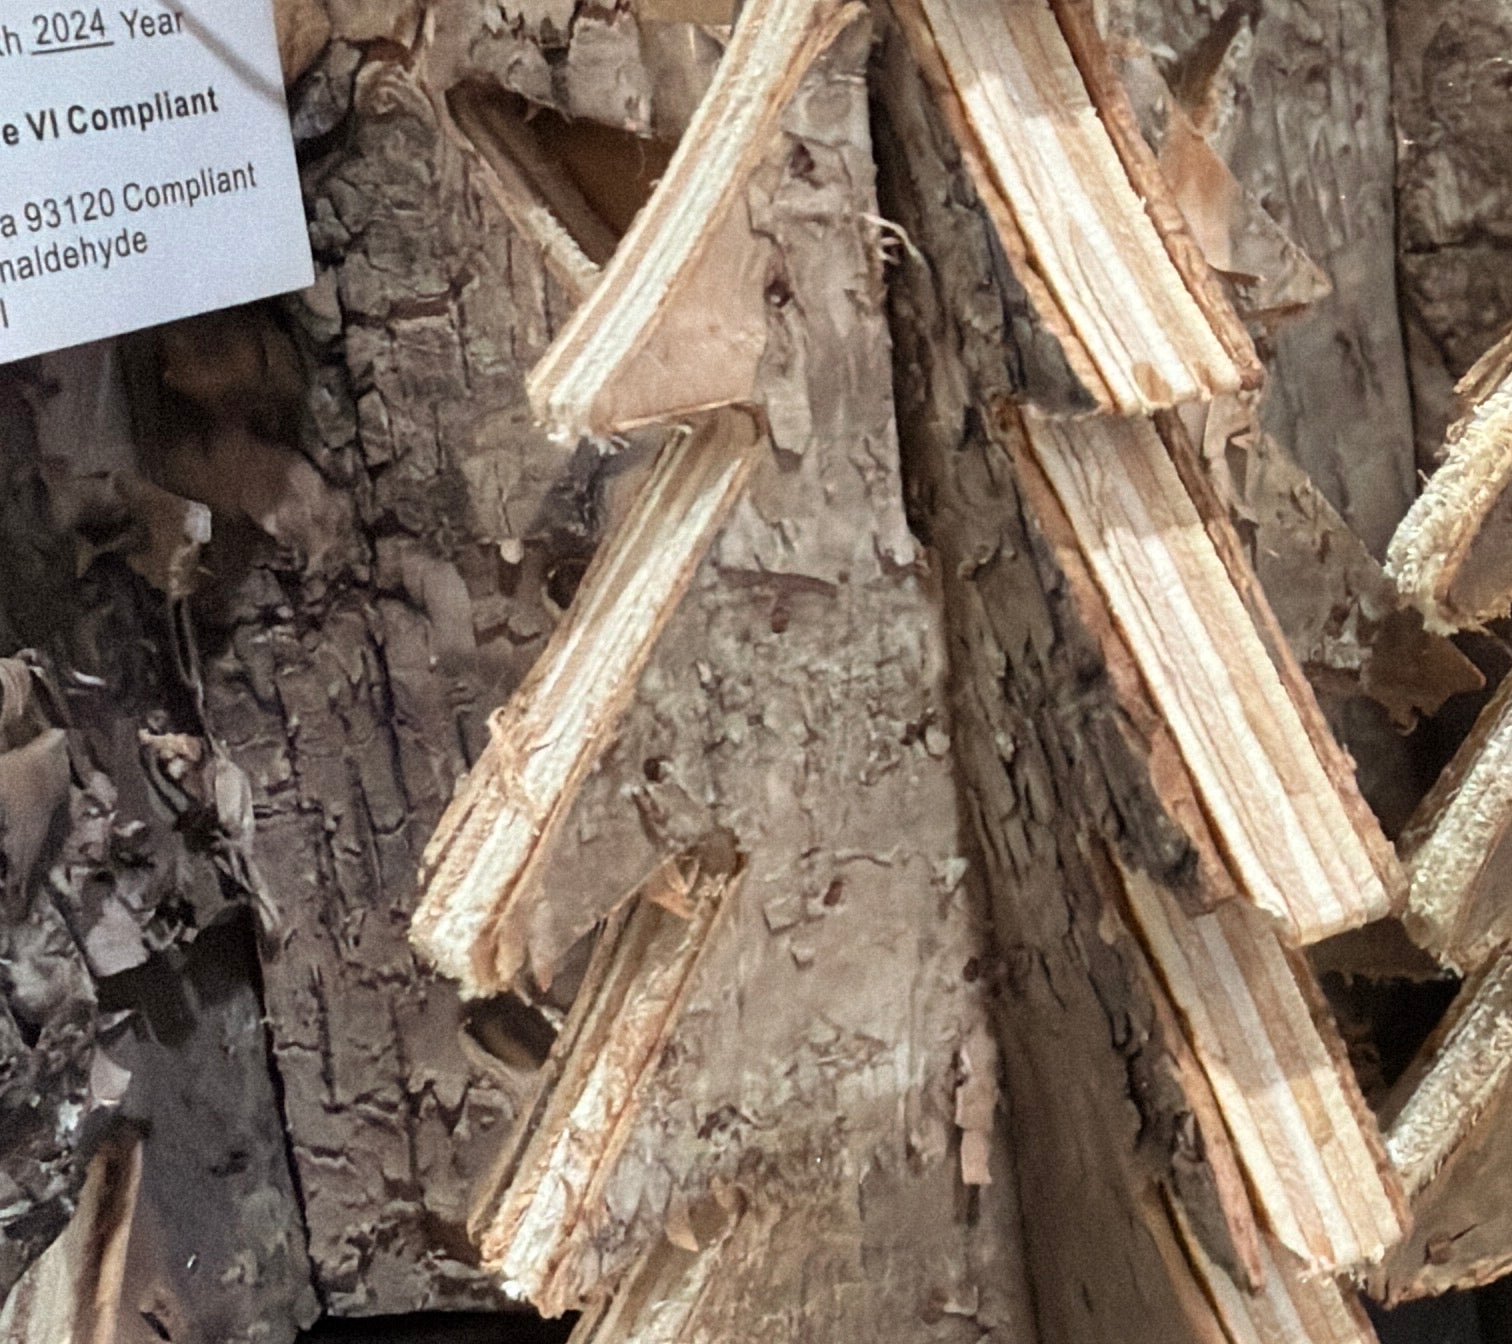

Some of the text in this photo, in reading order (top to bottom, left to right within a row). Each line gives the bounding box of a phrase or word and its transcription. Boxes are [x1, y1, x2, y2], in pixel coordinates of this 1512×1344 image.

[0, 8, 184, 56] h 2024 Year
[25, 108, 60, 141] VI
[67, 86, 219, 135] Compliant
[24, 188, 116, 233] 93120
[123, 162, 257, 212] Compliant
